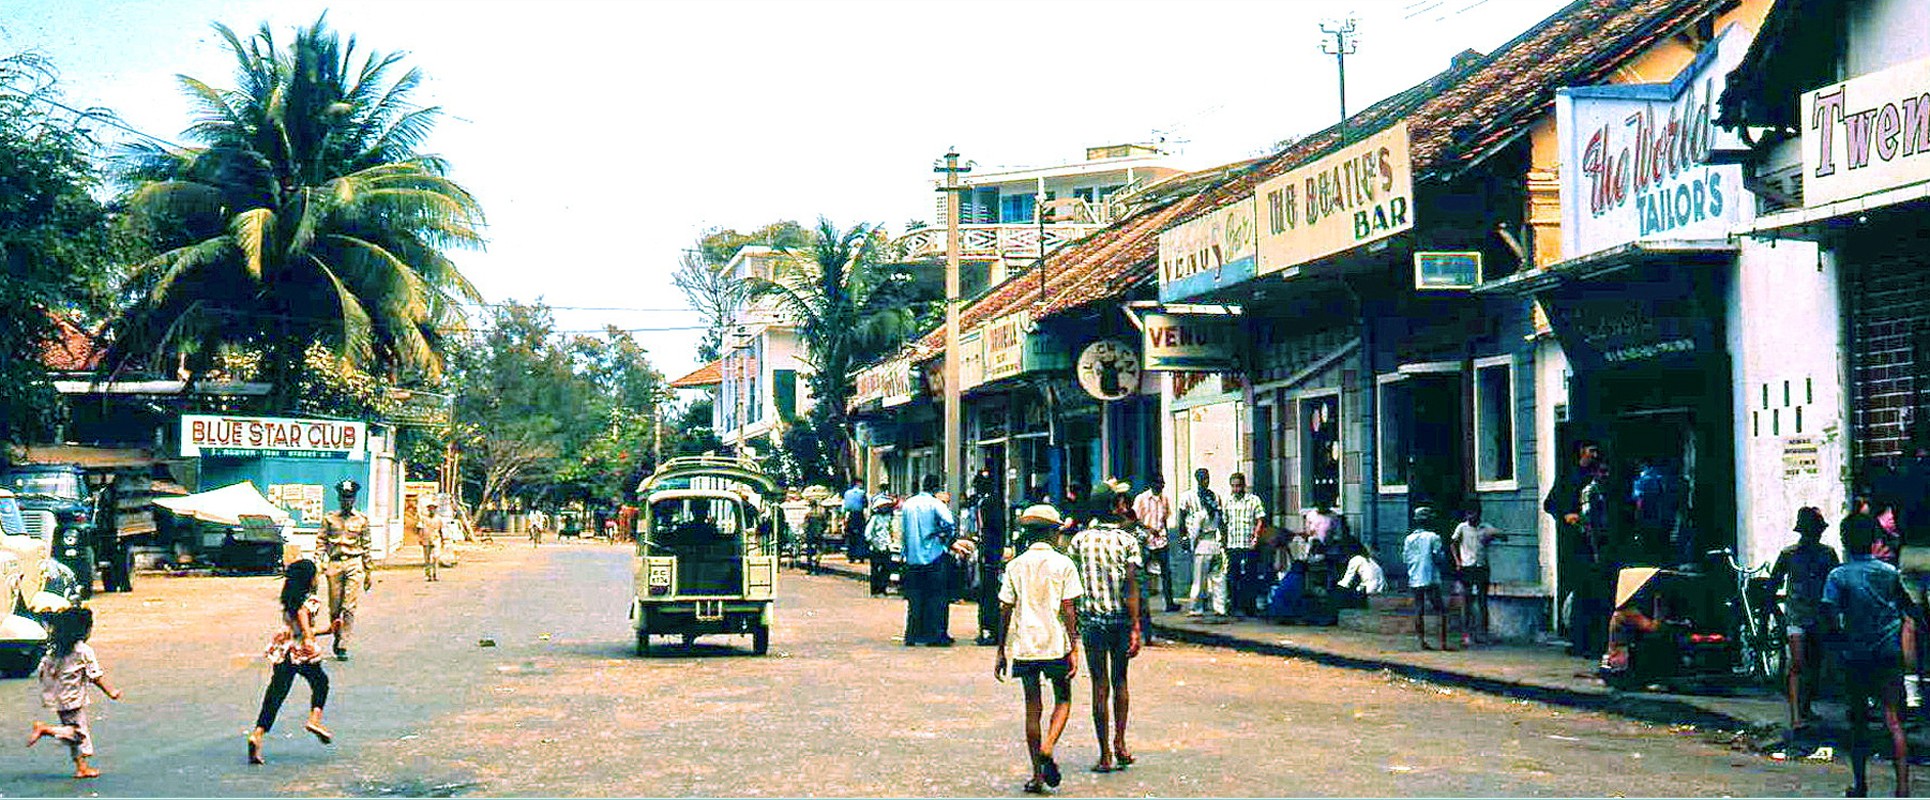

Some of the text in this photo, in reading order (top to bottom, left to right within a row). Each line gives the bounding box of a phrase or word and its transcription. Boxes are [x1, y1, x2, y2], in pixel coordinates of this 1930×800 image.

[1626, 77, 1717, 192] World
[1812, 84, 1930, 178] Twen
[1354, 196, 1407, 240] BAR
[192, 420, 356, 449] BLUE STAR CLUB
